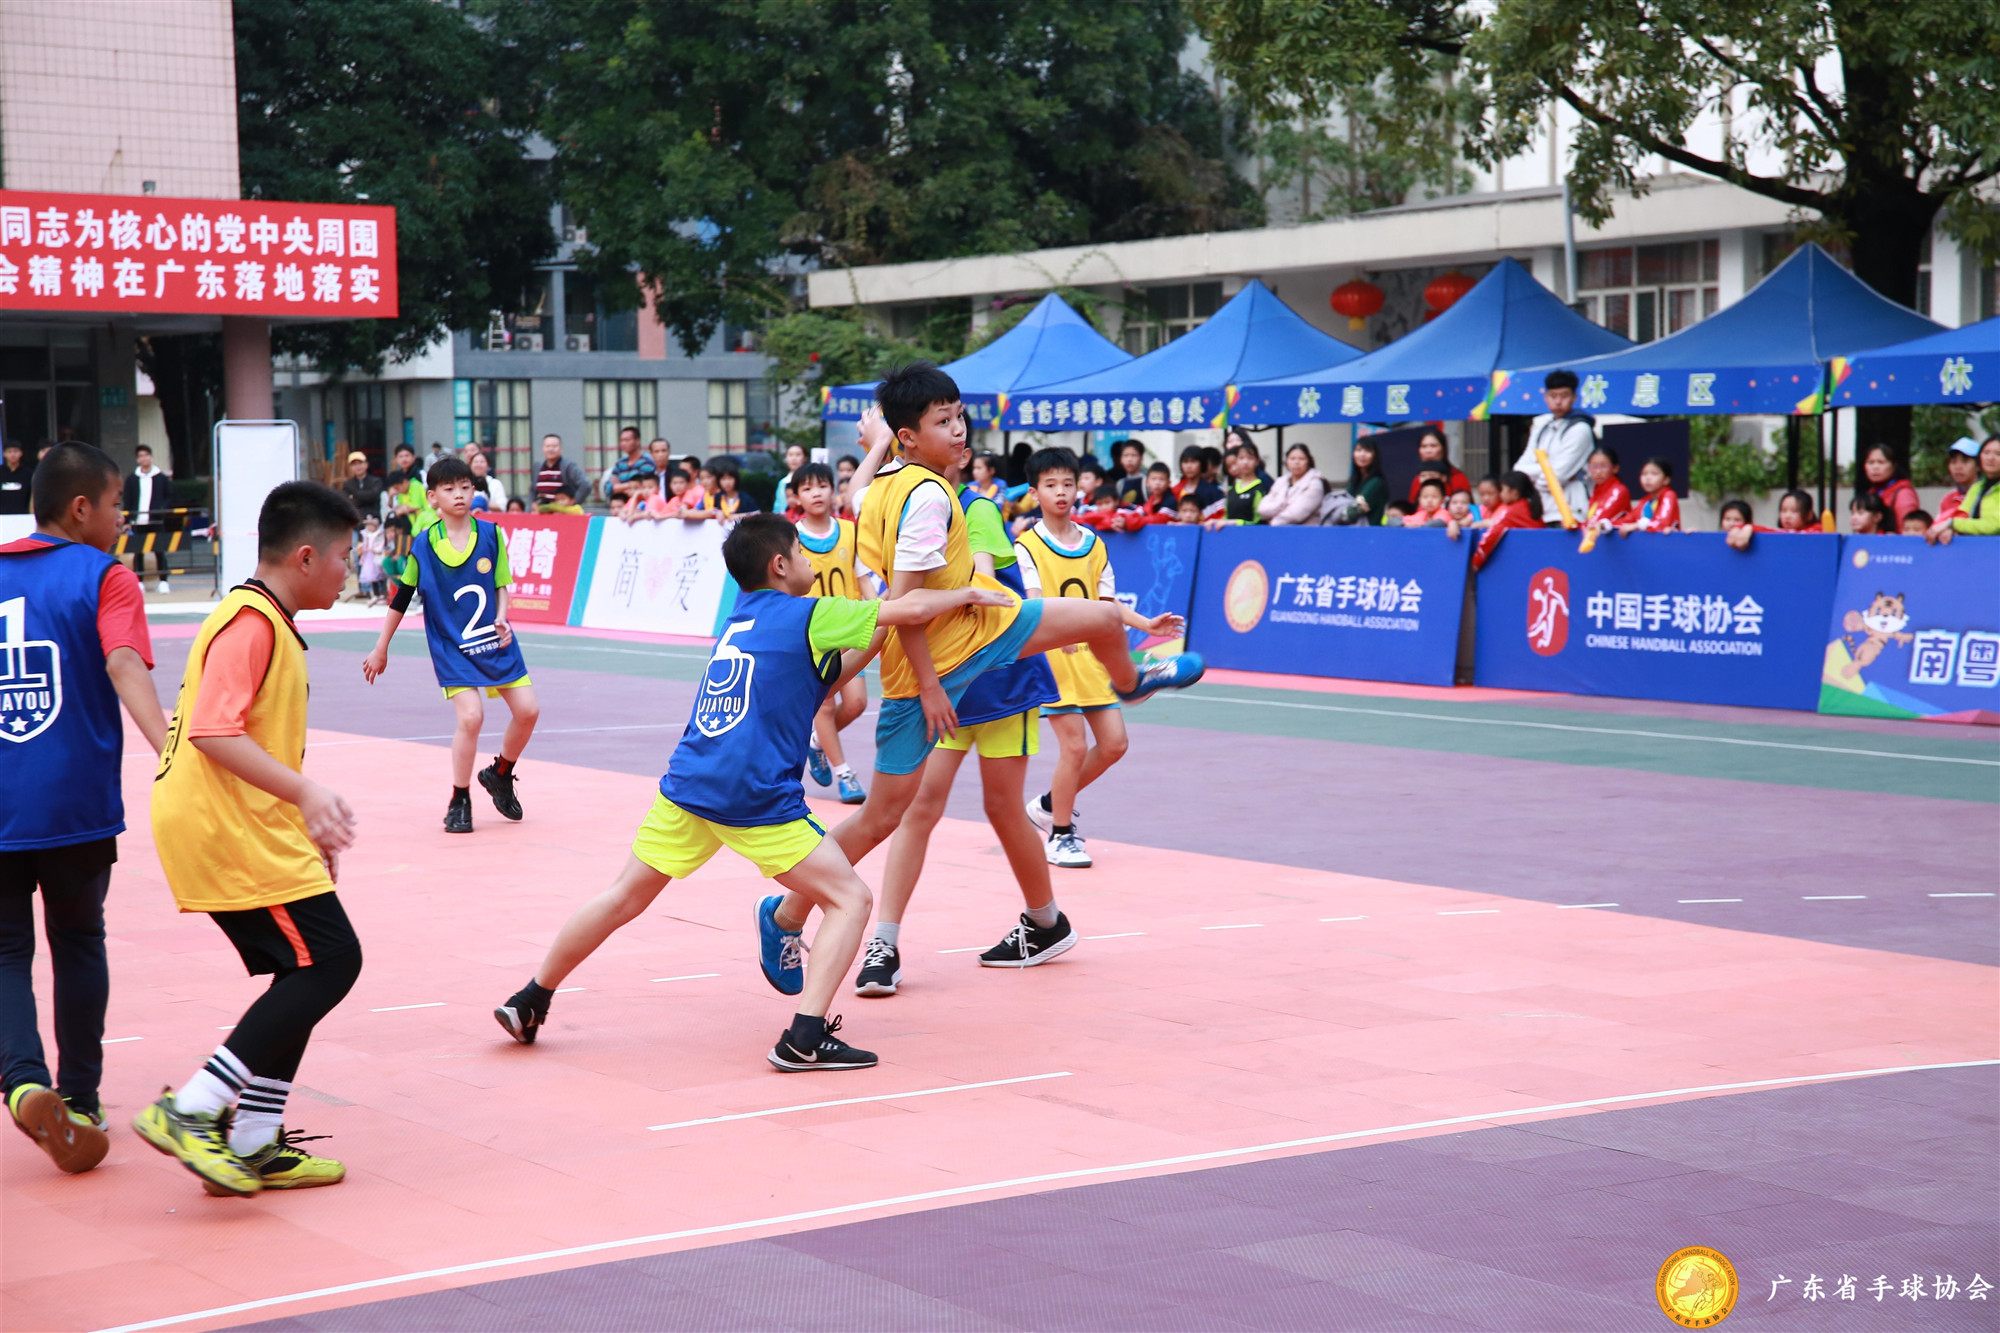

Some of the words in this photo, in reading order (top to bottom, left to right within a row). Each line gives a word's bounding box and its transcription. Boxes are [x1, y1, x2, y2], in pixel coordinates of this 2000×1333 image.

[0, 205, 379, 258] 同志为核心的党中央周围
[1297, 383, 1411, 418] 休息区
[1580, 372, 1717, 408] 休息区
[1272, 572, 1423, 613] 广东省手球协会
[453, 584, 495, 640] 2
[1319, 613, 1362, 628] HANDBALL
[1363, 615, 1420, 631] ASSOCIATION
[1586, 590, 1764, 635] 中国手球协会
[705, 618, 755, 695] 5
[1586, 633, 1629, 650] CHINESE
[1630, 637, 1687, 653] HANDBALL
[1688, 639, 1763, 656] ASSOCIATION
[699, 696, 741, 714] JIAYOU
